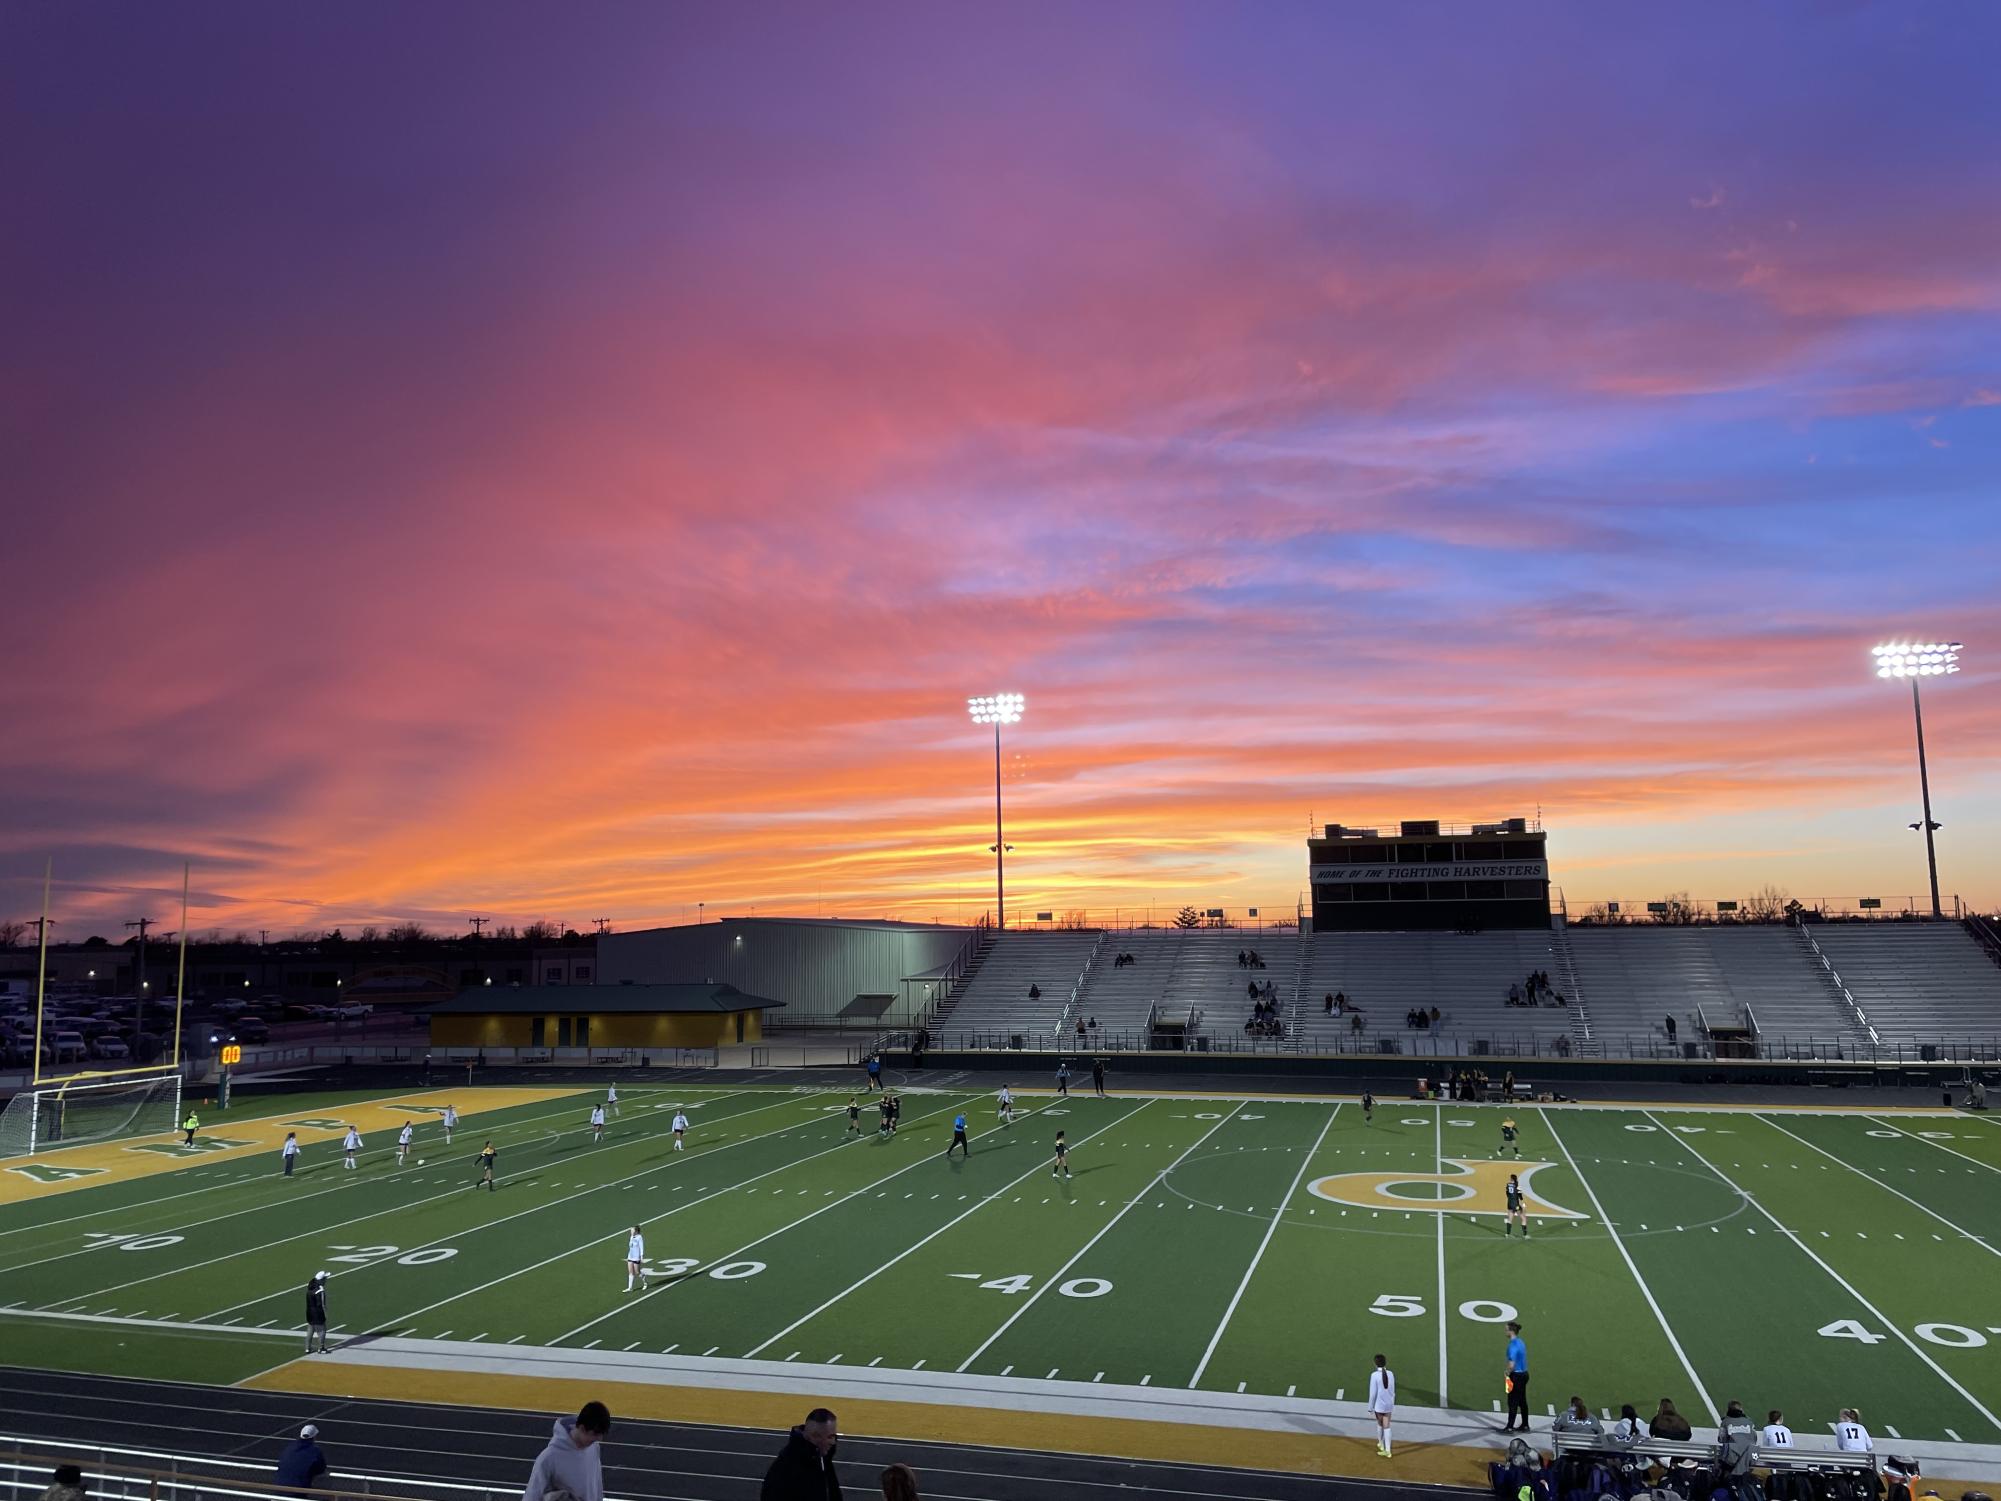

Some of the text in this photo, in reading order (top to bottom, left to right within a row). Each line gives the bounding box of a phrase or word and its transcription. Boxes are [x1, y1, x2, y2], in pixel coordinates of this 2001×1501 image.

[1317, 865, 1541, 879] HOME OF THE FIGHTING HARVESTERS
[222, 1045, 241, 1064] 00
[327, 1245, 458, 1264] 20
[640, 1258, 767, 1280] 30
[978, 1273, 1114, 1298] 40
[1367, 1294, 1519, 1323] 50
[1816, 1318, 1988, 1348] 40
[1774, 1431, 1786, 1444] 11
[1845, 1427, 1859, 1439] 17
